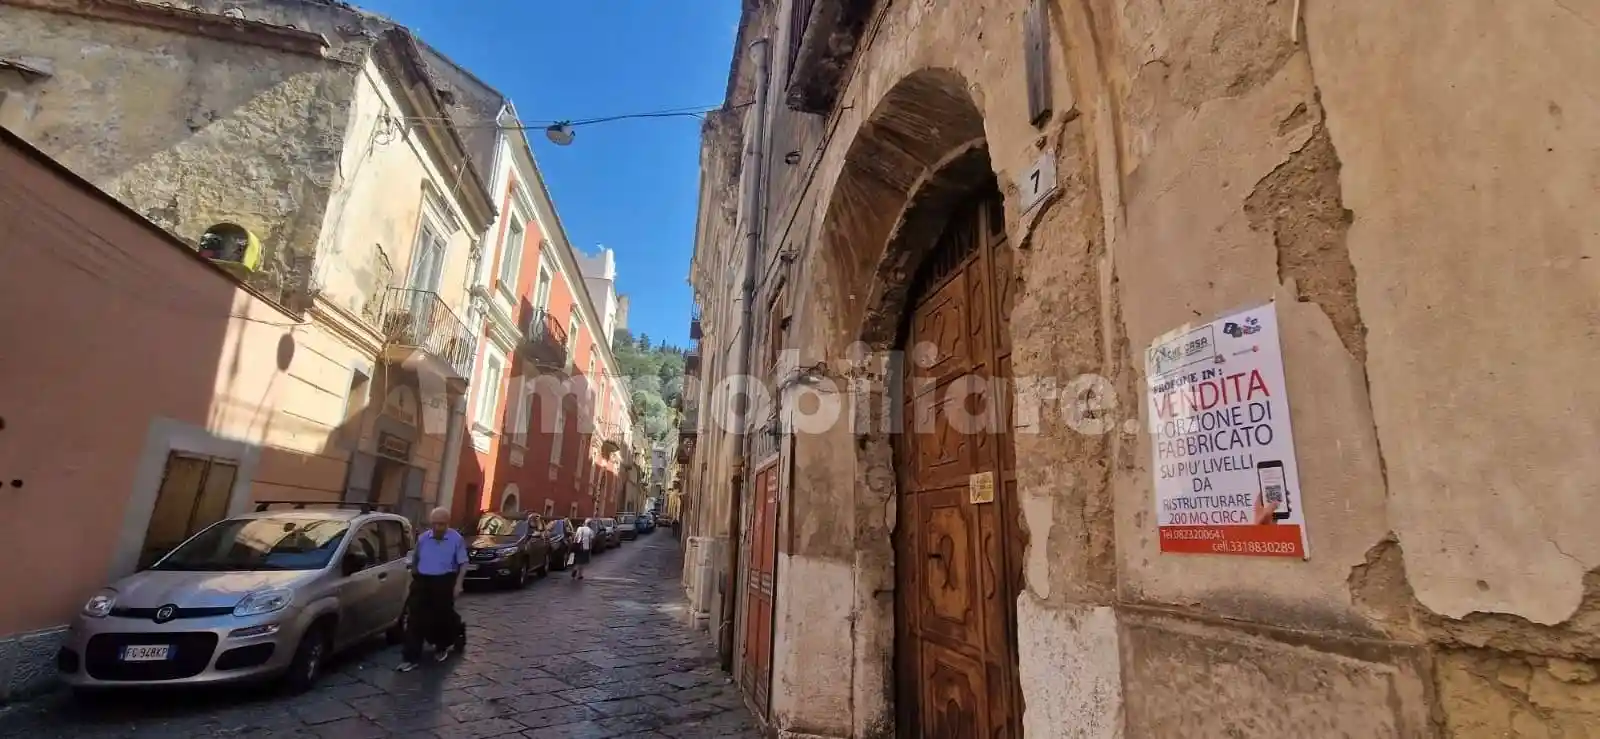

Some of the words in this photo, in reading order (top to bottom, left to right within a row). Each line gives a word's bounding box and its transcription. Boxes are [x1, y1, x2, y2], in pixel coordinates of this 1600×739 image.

[1030, 168, 1040, 194] 7
[1153, 369, 1271, 420] VENDITA
[1156, 406, 1243, 440] PORZIONE
[1248, 400, 1273, 423] DI
[1158, 424, 1274, 460] FABBRICATO
[1160, 464, 1175, 480] SU
[1203, 454, 1254, 475] LIVELLI
[1192, 478, 1213, 493] DA
[1163, 493, 1253, 512] RISTRUTTURARE
[1169, 512, 1188, 525] 200
[1189, 511, 1209, 525] MQ
[1211, 510, 1249, 524] CIRCA
